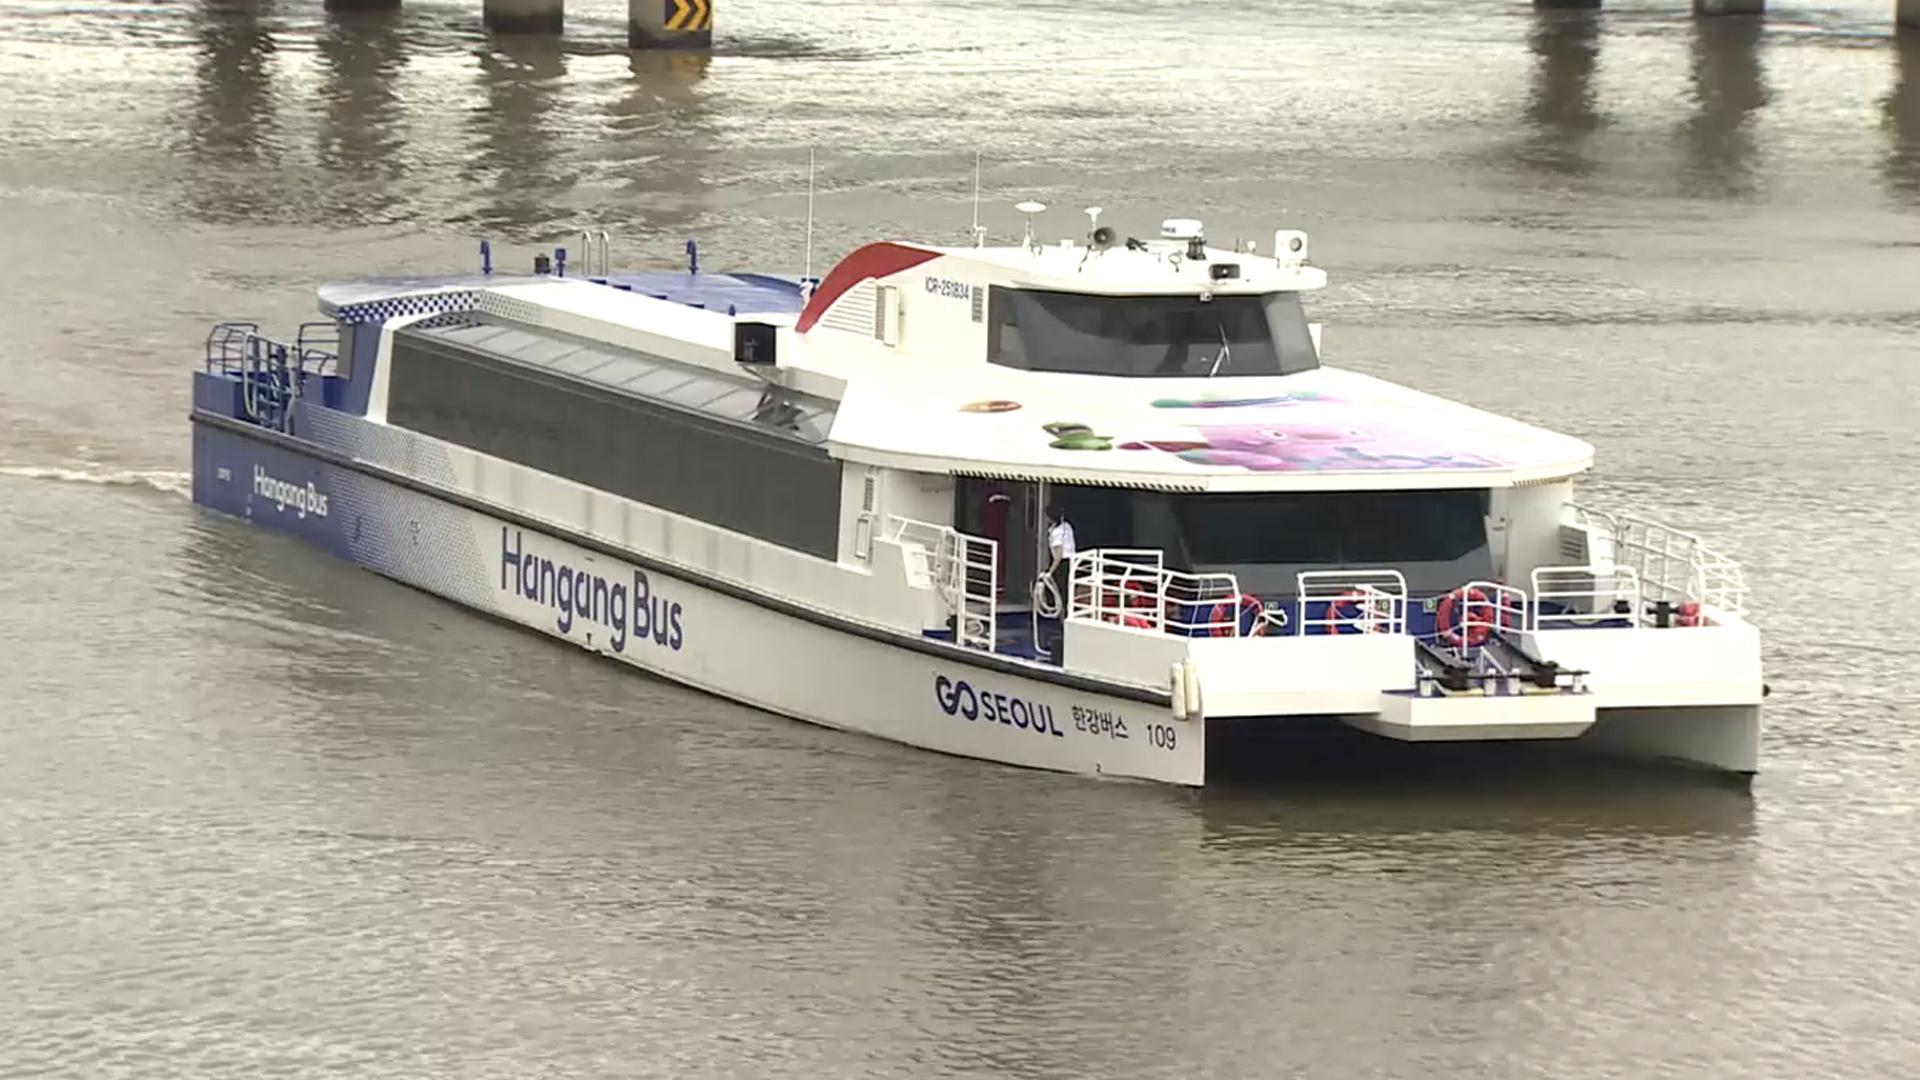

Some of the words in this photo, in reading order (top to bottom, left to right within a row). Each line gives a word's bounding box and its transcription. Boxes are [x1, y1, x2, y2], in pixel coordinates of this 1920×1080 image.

[254, 464, 305, 518] Hangang
[307, 482, 327, 516] Bus
[502, 526, 626, 652] Hangang
[633, 570, 682, 650] Bus
[981, 691, 1064, 737] SEOUL
[1072, 705, 1128, 739] 한강버스
[1147, 724, 1176, 750] 109
